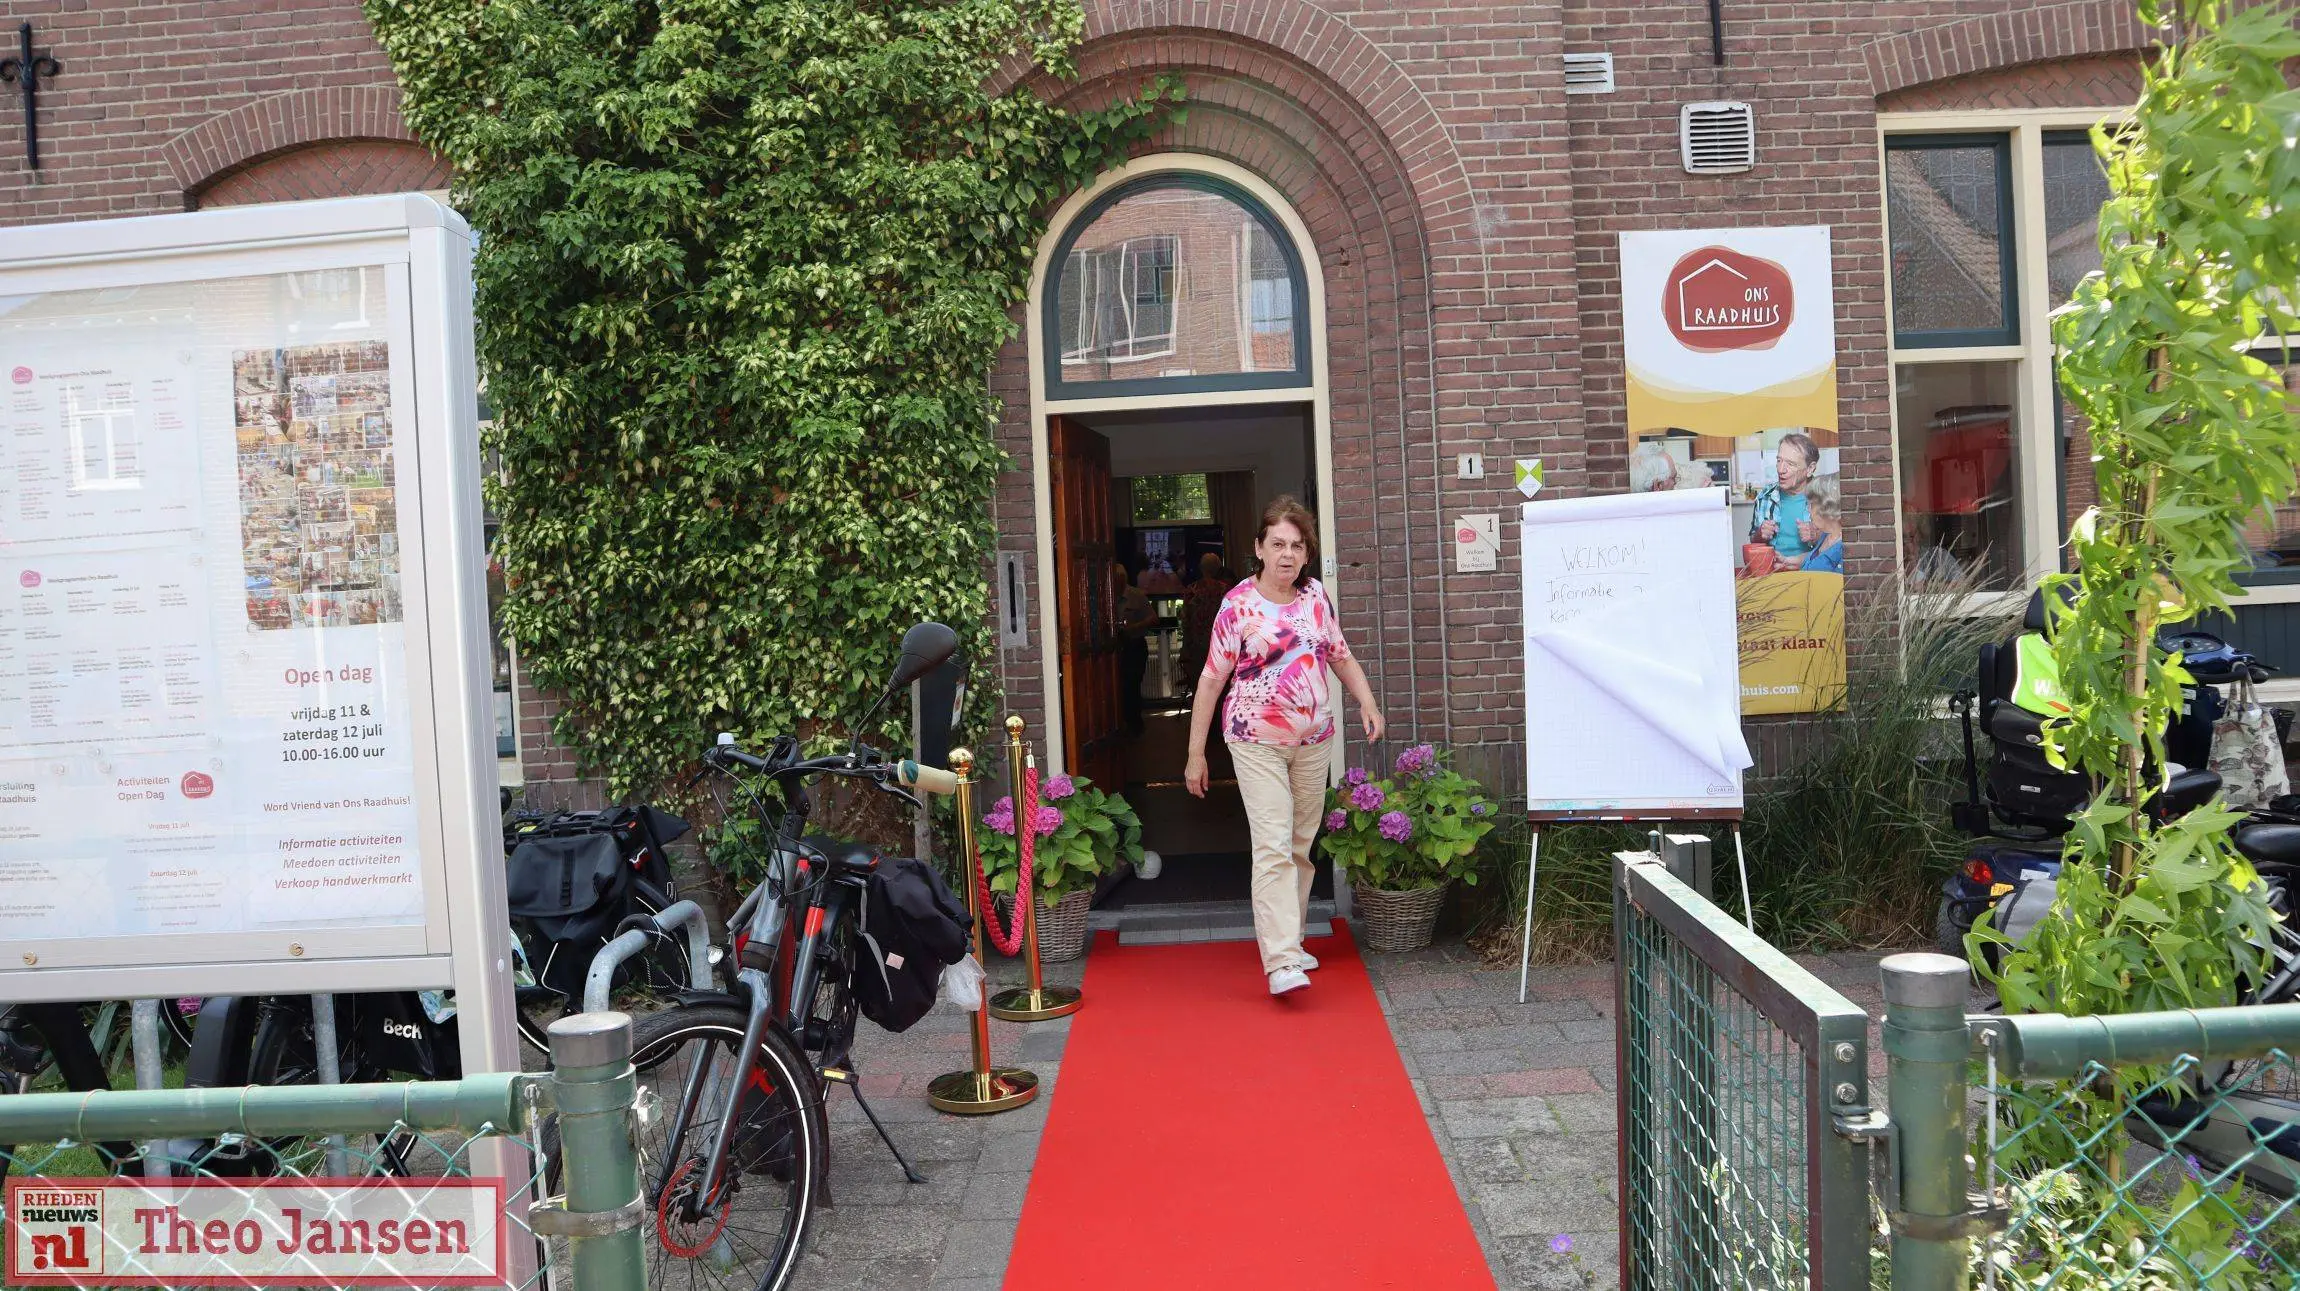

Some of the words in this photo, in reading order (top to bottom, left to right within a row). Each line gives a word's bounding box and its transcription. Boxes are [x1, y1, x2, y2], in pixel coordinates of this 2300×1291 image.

[1744, 286, 1769, 302] ONS
[1695, 304, 1780, 325] RAADHUIS
[1467, 457, 1473, 474] 1
[1487, 518, 1493, 532] 1
[1561, 536, 1647, 571] WELKOM!
[1545, 580, 1616, 605] Informatie
[1781, 636, 1826, 650] klaar
[284, 668, 334, 687] Open
[339, 664, 373, 684] dag
[291, 706, 336, 722] vrijdag
[340, 705, 356, 717] 11
[360, 703, 371, 717] &
[283, 727, 339, 741] zaterdag
[342, 725, 359, 738] 12
[362, 724, 383, 740] juli
[282, 746, 359, 762] 10.00-16.00
[363, 747, 386, 758] uur
[117, 776, 170, 787] Activiteiten
[118, 792, 143, 802] Open
[146, 790, 165, 801] Dag
[263, 801, 288, 812] Word
[291, 800, 321, 811] Vriend
[343, 799, 362, 808] Ons
[364, 796, 411, 808] Raadhuis!
[278, 836, 337, 851] Informatie
[339, 835, 402, 847] activiteiten
[283, 857, 335, 869] Meedoen
[338, 853, 401, 867] activiteiten
[275, 877, 320, 890] Verkoop
[322, 872, 413, 887] handwerkmarkt
